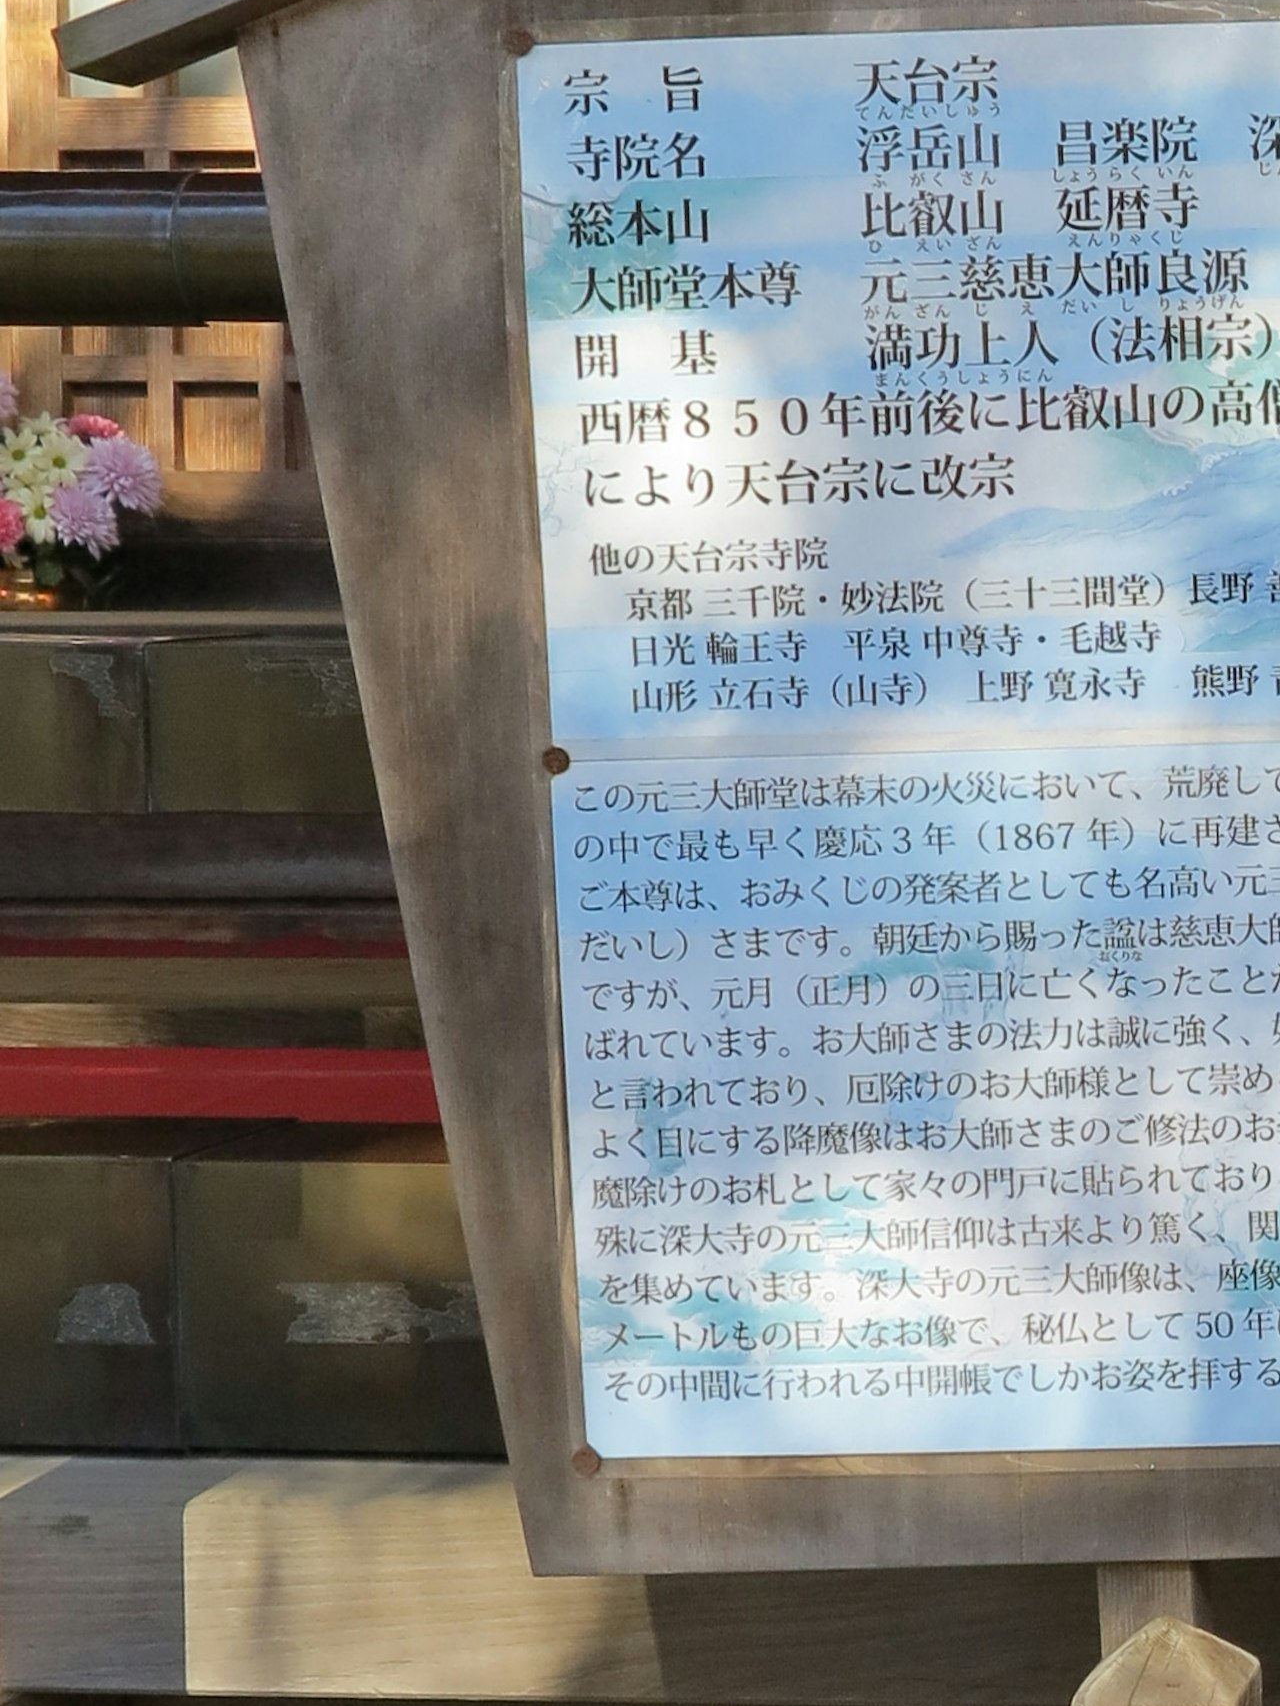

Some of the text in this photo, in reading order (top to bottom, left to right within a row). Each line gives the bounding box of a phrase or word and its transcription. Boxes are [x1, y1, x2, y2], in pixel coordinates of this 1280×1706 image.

[854, 55, 999, 106] 天台宗
[566, 132, 706, 181] 寺院名
[857, 121, 1000, 173] 浮岳山
[1055, 117, 1198, 166] 昌楽院
[567, 182, 1200, 248] 総本山 比叡山 延暦寺
[571, 247, 1249, 315] 大師堂本尊 元三慈恵大師良源
[584, 453, 1015, 508] により天台宗に改宗
[590, 536, 830, 577] 他の天台宗寺院
[625, 587, 693, 621] 京都
[1188, 571, 1254, 605] 長野
[631, 619, 1161, 667] 日光 輪王寺 平泉 中尊寺・毛越寺
[631, 678, 697, 713] 山形
[965, 669, 1034, 705] 上野
[1191, 664, 1260, 699] 熊野
